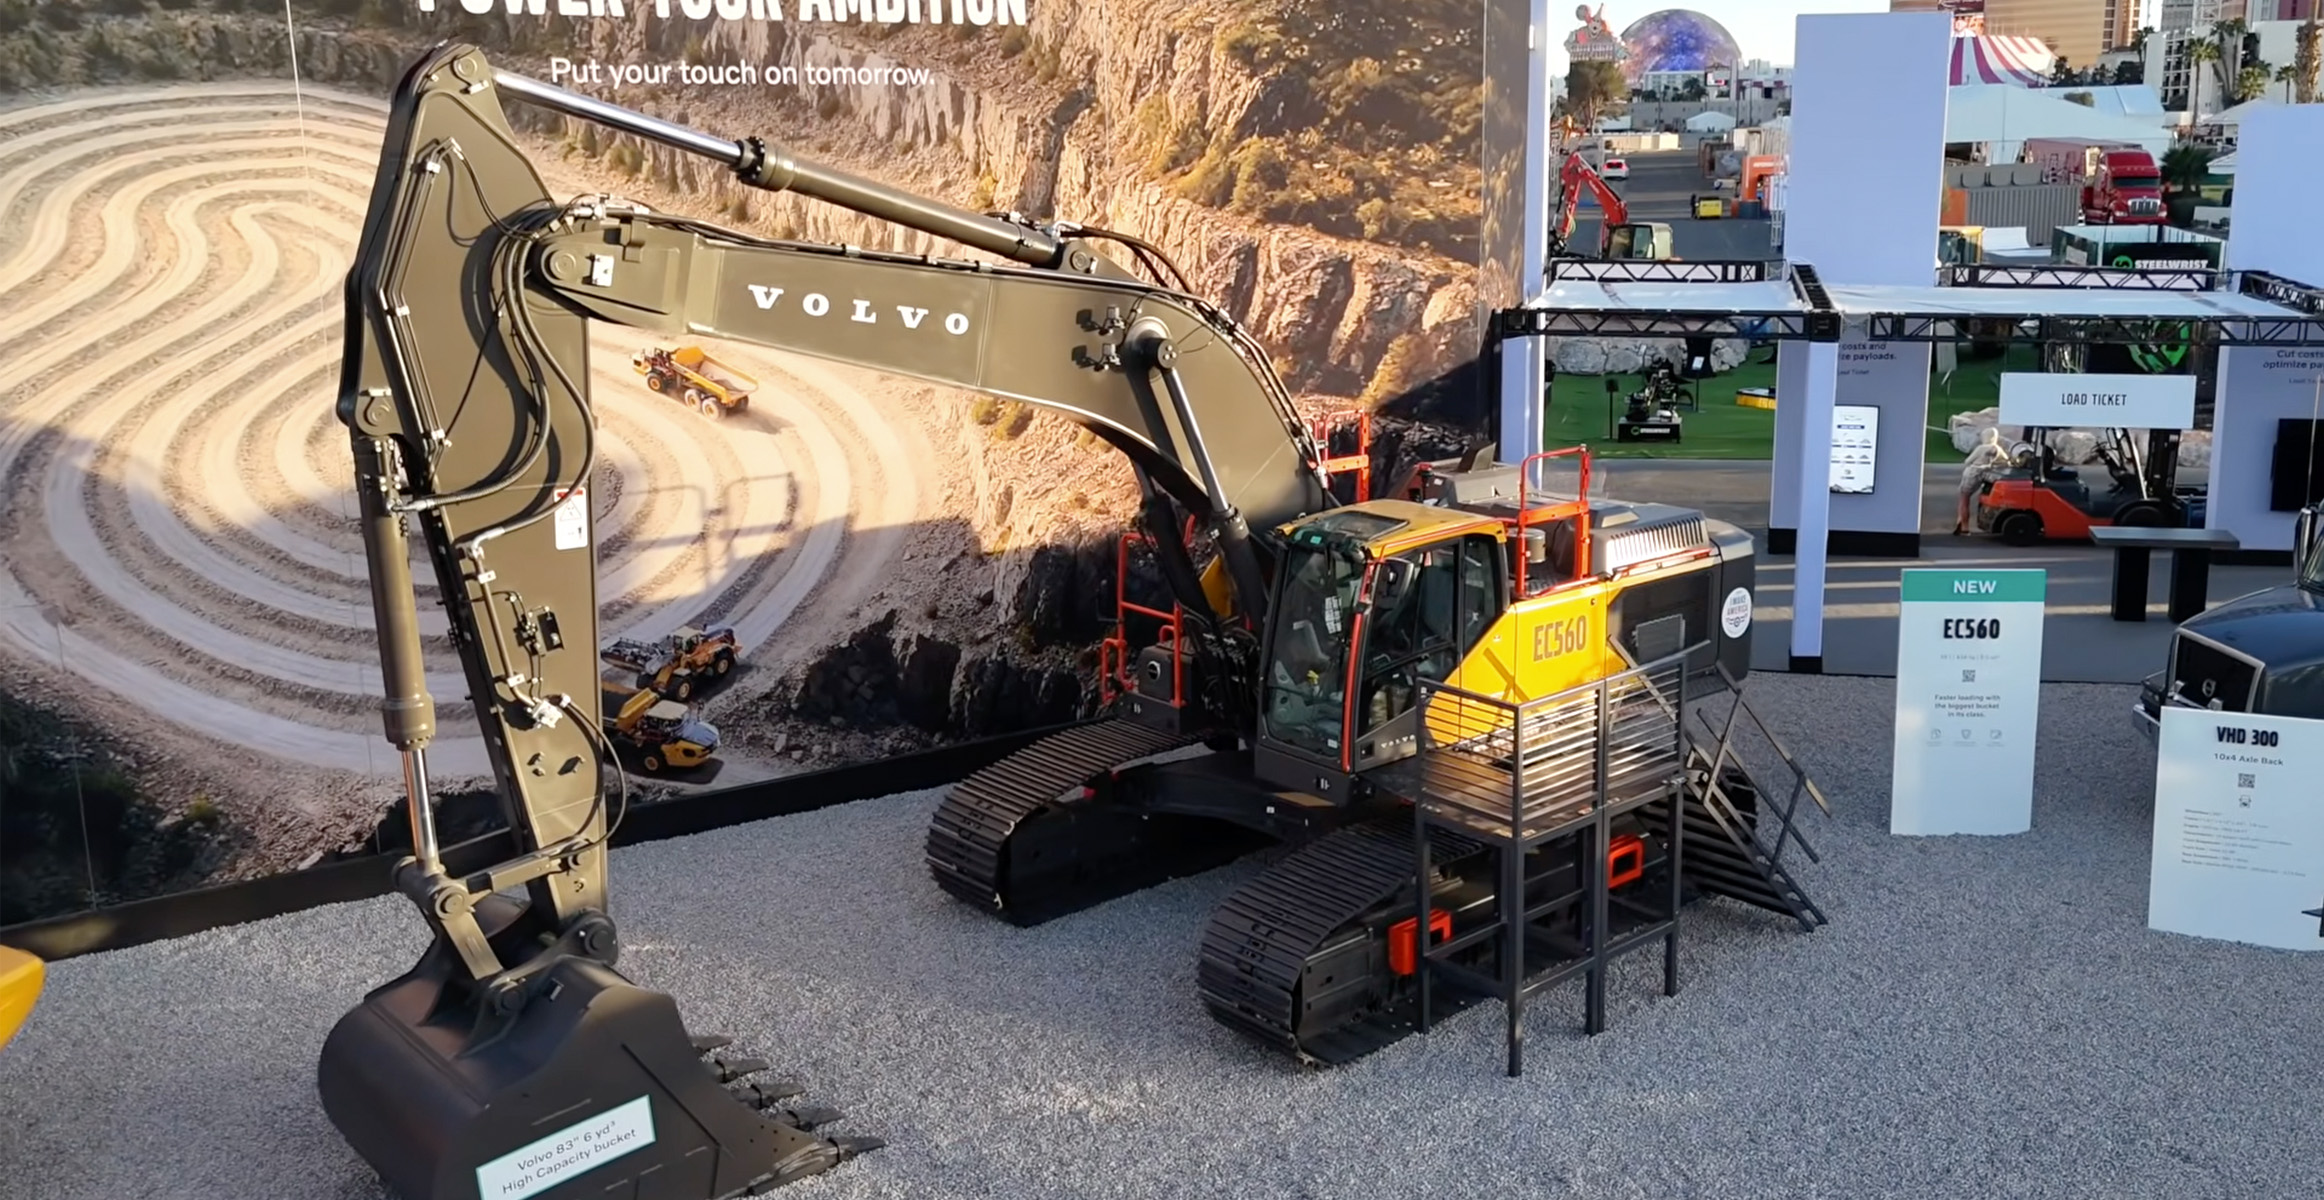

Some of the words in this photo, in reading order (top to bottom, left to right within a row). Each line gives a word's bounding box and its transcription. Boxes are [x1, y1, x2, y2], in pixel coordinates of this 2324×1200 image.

[551, 57, 600, 83] Put
[609, 63, 678, 89] your
[680, 59, 757, 85] touch
[764, 66, 797, 85] on
[804, 61, 935, 86] tomorrow.
[2134, 259, 2208, 269] STEELWRIST
[748, 284, 969, 335] VOLVO
[2061, 393, 2088, 405] LOAD
[2092, 393, 2127, 406] TICKET
[1953, 580, 1997, 594] NEW
[1533, 615, 1586, 662] EC560
[1943, 618, 2000, 639] EC560
[2216, 726, 2246, 744] VHD
[2251, 729, 2278, 747] 300
[2214, 753, 2236, 761] 10x4
[2239, 755, 2259, 763] Axle
[2261, 757, 2283, 766] Back
[501, 1174, 533, 1194] High
[536, 1150, 591, 1178] Capacity
[594, 1128, 637, 1153] bucket
[517, 1150, 553, 1171] Volvo
[583, 1131, 592, 1143] 6
